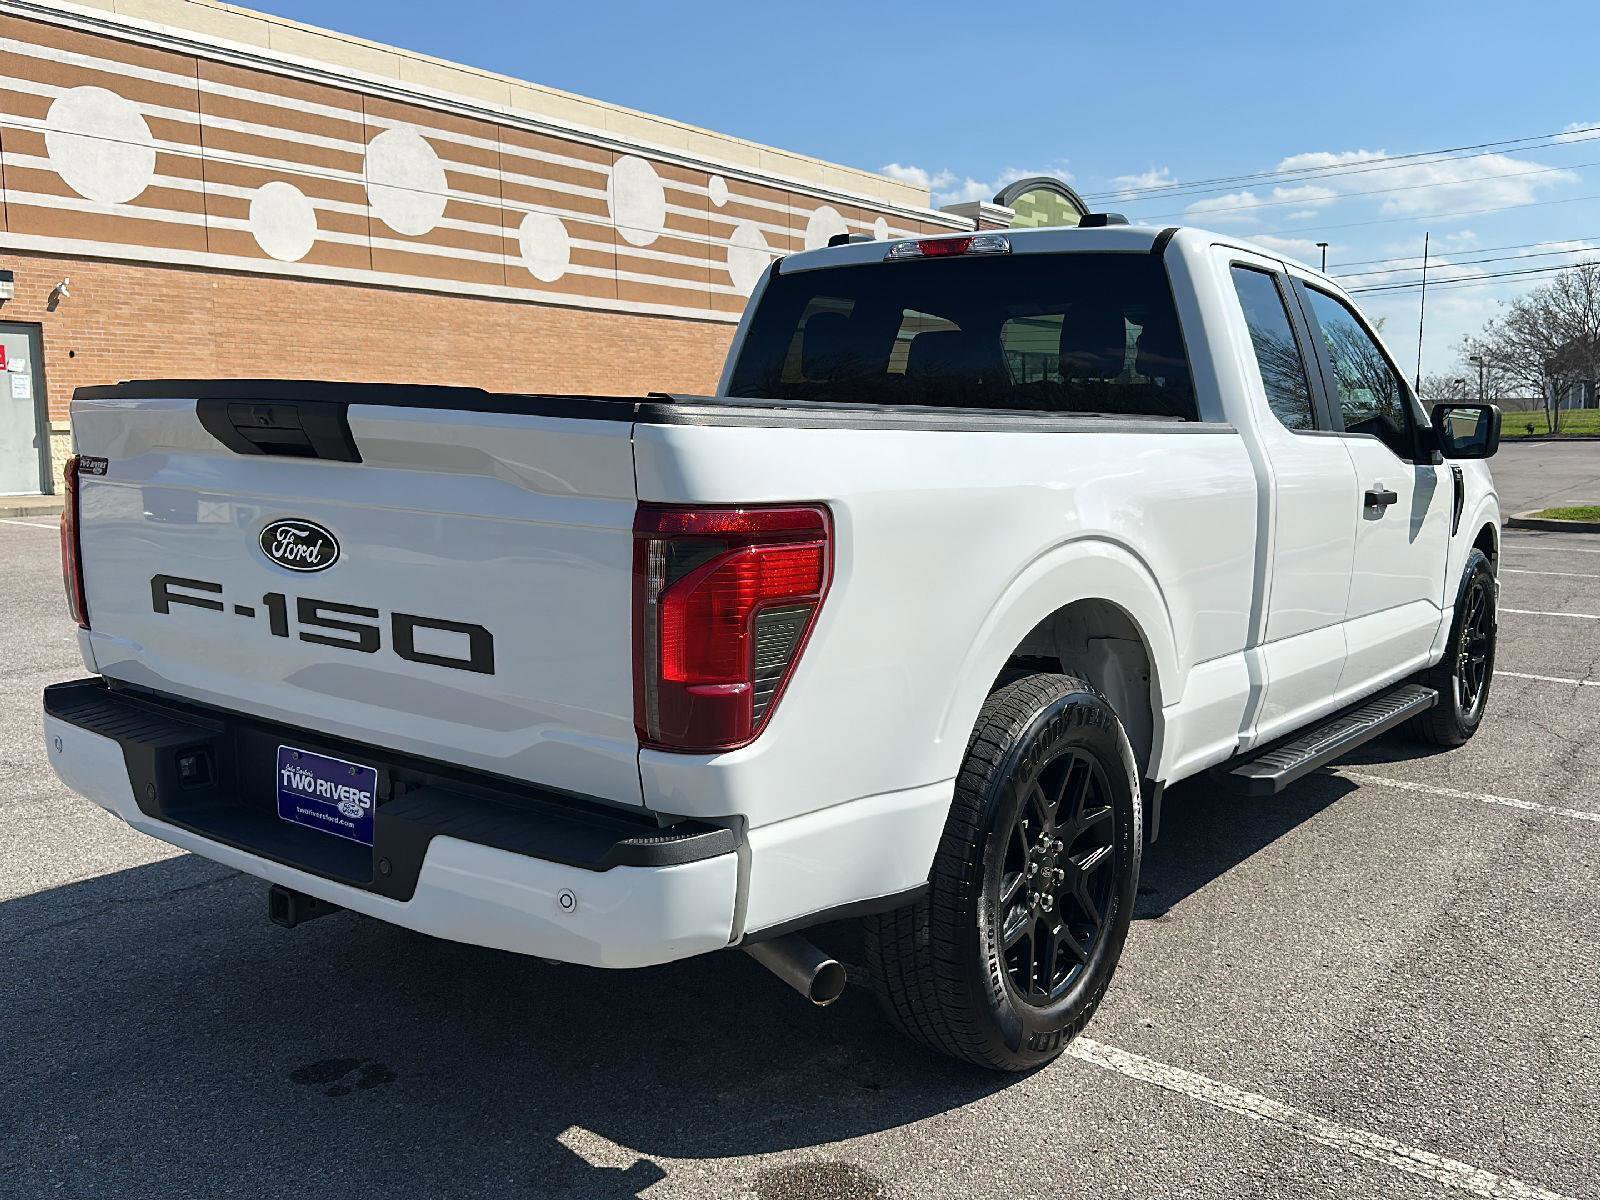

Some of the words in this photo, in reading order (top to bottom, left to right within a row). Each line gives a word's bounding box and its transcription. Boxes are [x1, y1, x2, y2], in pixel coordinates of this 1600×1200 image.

[272, 526, 323, 564] Ford
[150, 573, 495, 675] F-150
[281, 769, 315, 793] TWO
[316, 779, 371, 809] RIVERS
[296, 806, 355, 829] tworiversford.com
